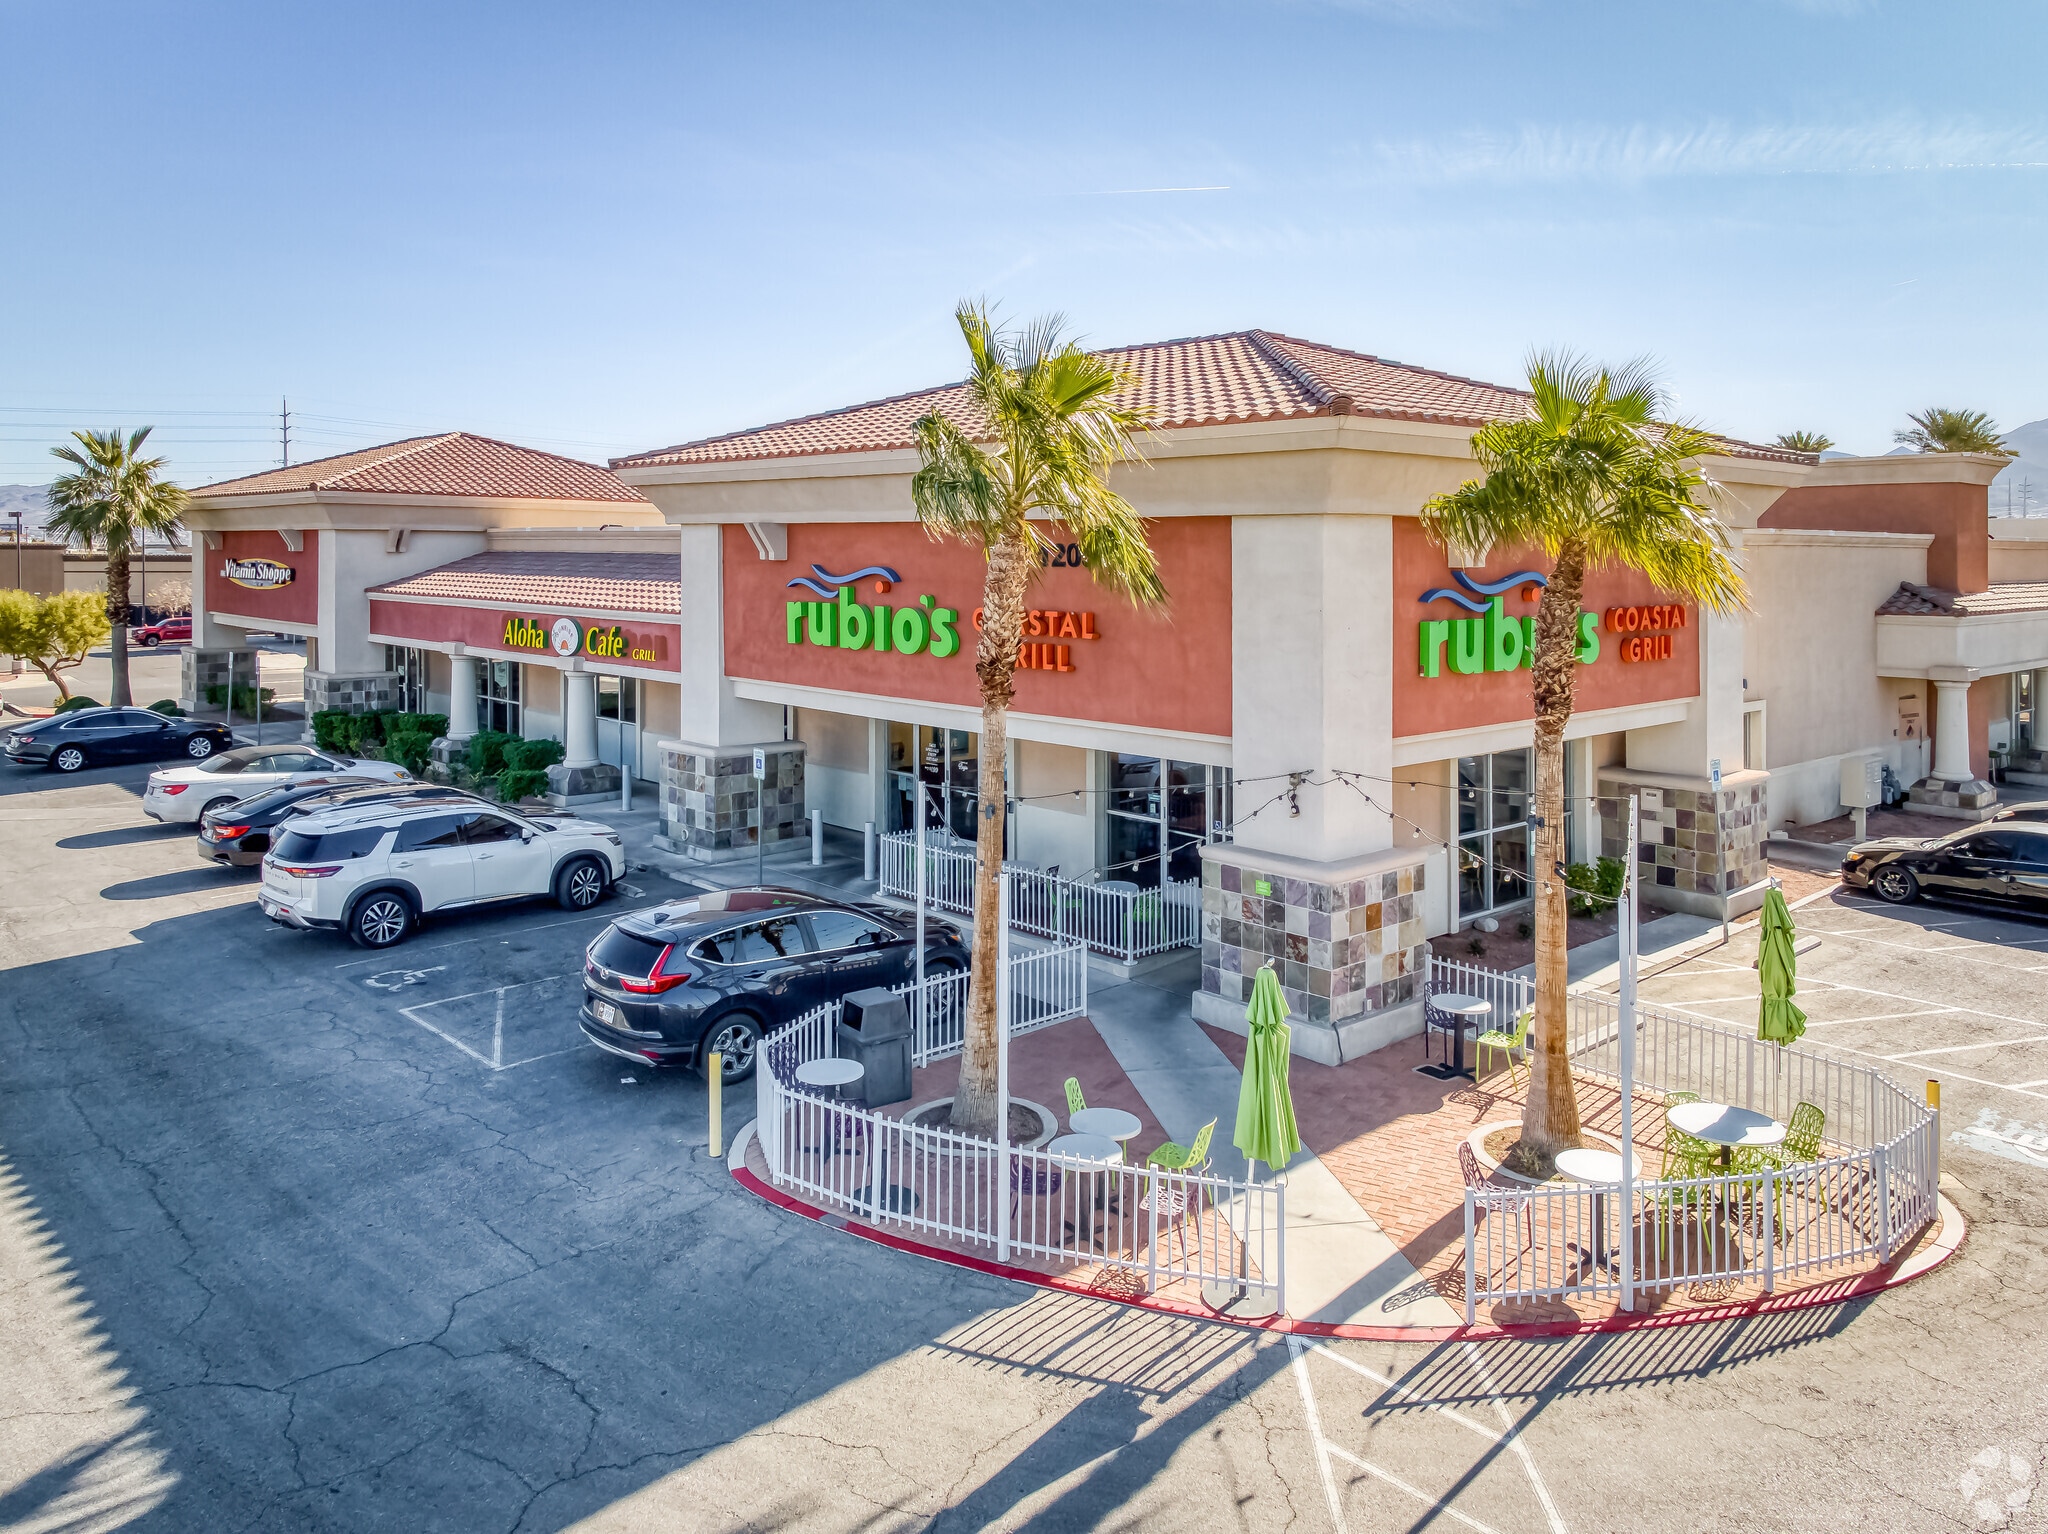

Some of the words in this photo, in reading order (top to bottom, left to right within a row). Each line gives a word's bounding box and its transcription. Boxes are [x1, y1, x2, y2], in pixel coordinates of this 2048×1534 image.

[225, 559, 256, 578] Vitamin
[256, 564, 292, 584] Shoppe
[503, 618, 548, 649] Aloha
[586, 626, 626, 658] Cafe
[632, 648, 656, 662] GRILL
[786, 580, 960, 658] rubio's
[1419, 588, 1600, 678] rubis
[1015, 643, 1075, 672] RILL
